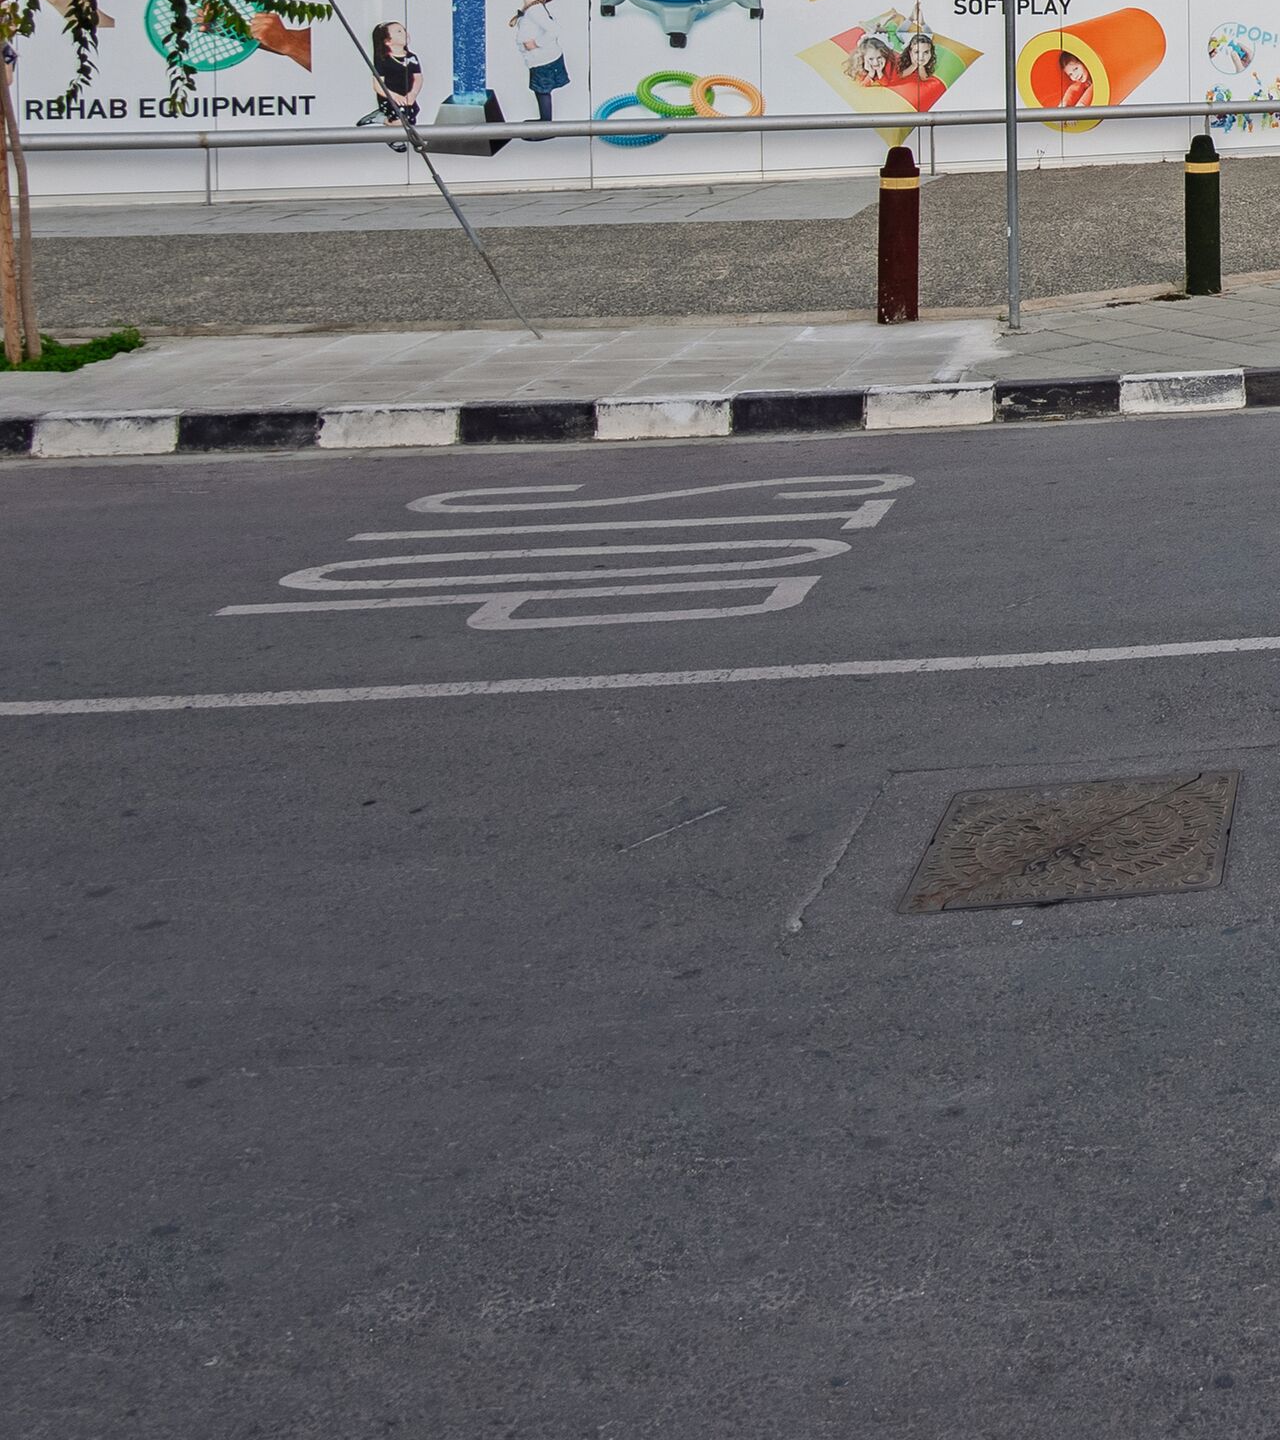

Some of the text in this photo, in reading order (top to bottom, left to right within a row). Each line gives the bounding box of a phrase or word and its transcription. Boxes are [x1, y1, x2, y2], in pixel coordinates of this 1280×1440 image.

[1236, 23, 1279, 48] POP!
[25, 98, 128, 120] REHAB
[213, 473, 916, 631] STOP
